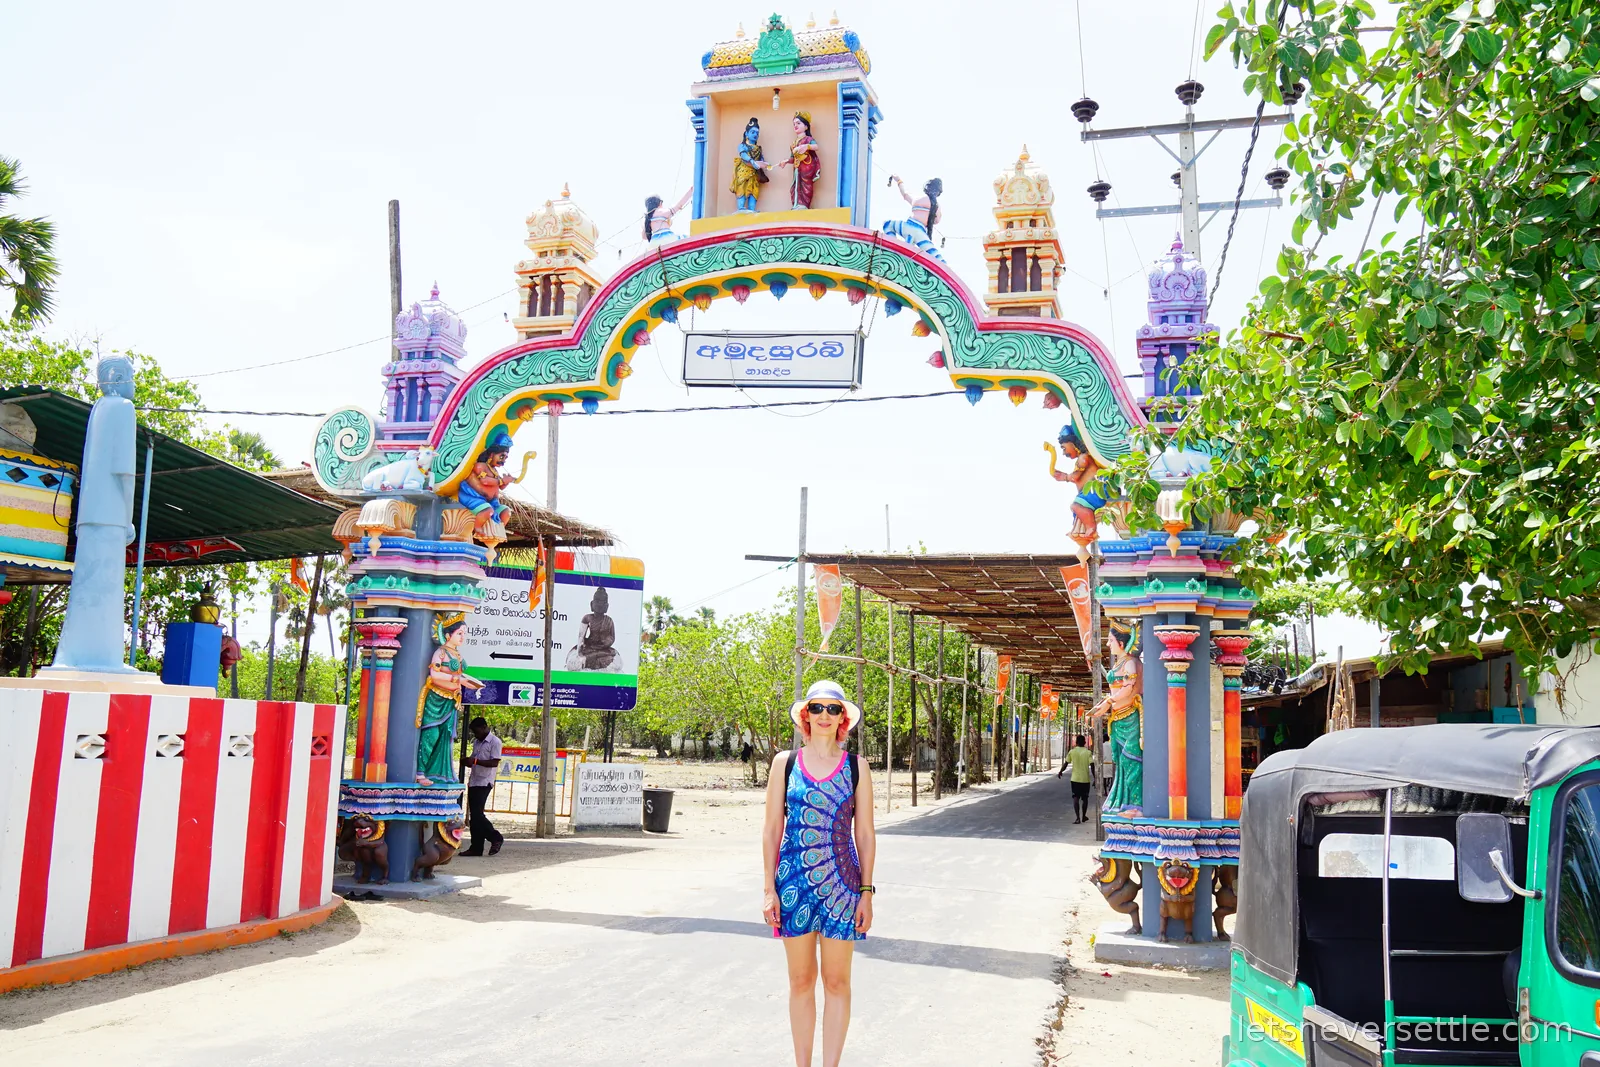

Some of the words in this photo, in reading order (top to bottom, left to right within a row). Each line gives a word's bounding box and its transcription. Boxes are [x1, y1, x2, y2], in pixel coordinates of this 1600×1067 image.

[540, 609, 567, 621] 50m
[467, 625, 489, 637] புத்த
[496, 627, 532, 638] வலவ்வ
[536, 639, 562, 649] 50m
[516, 764, 558, 773] RAM
